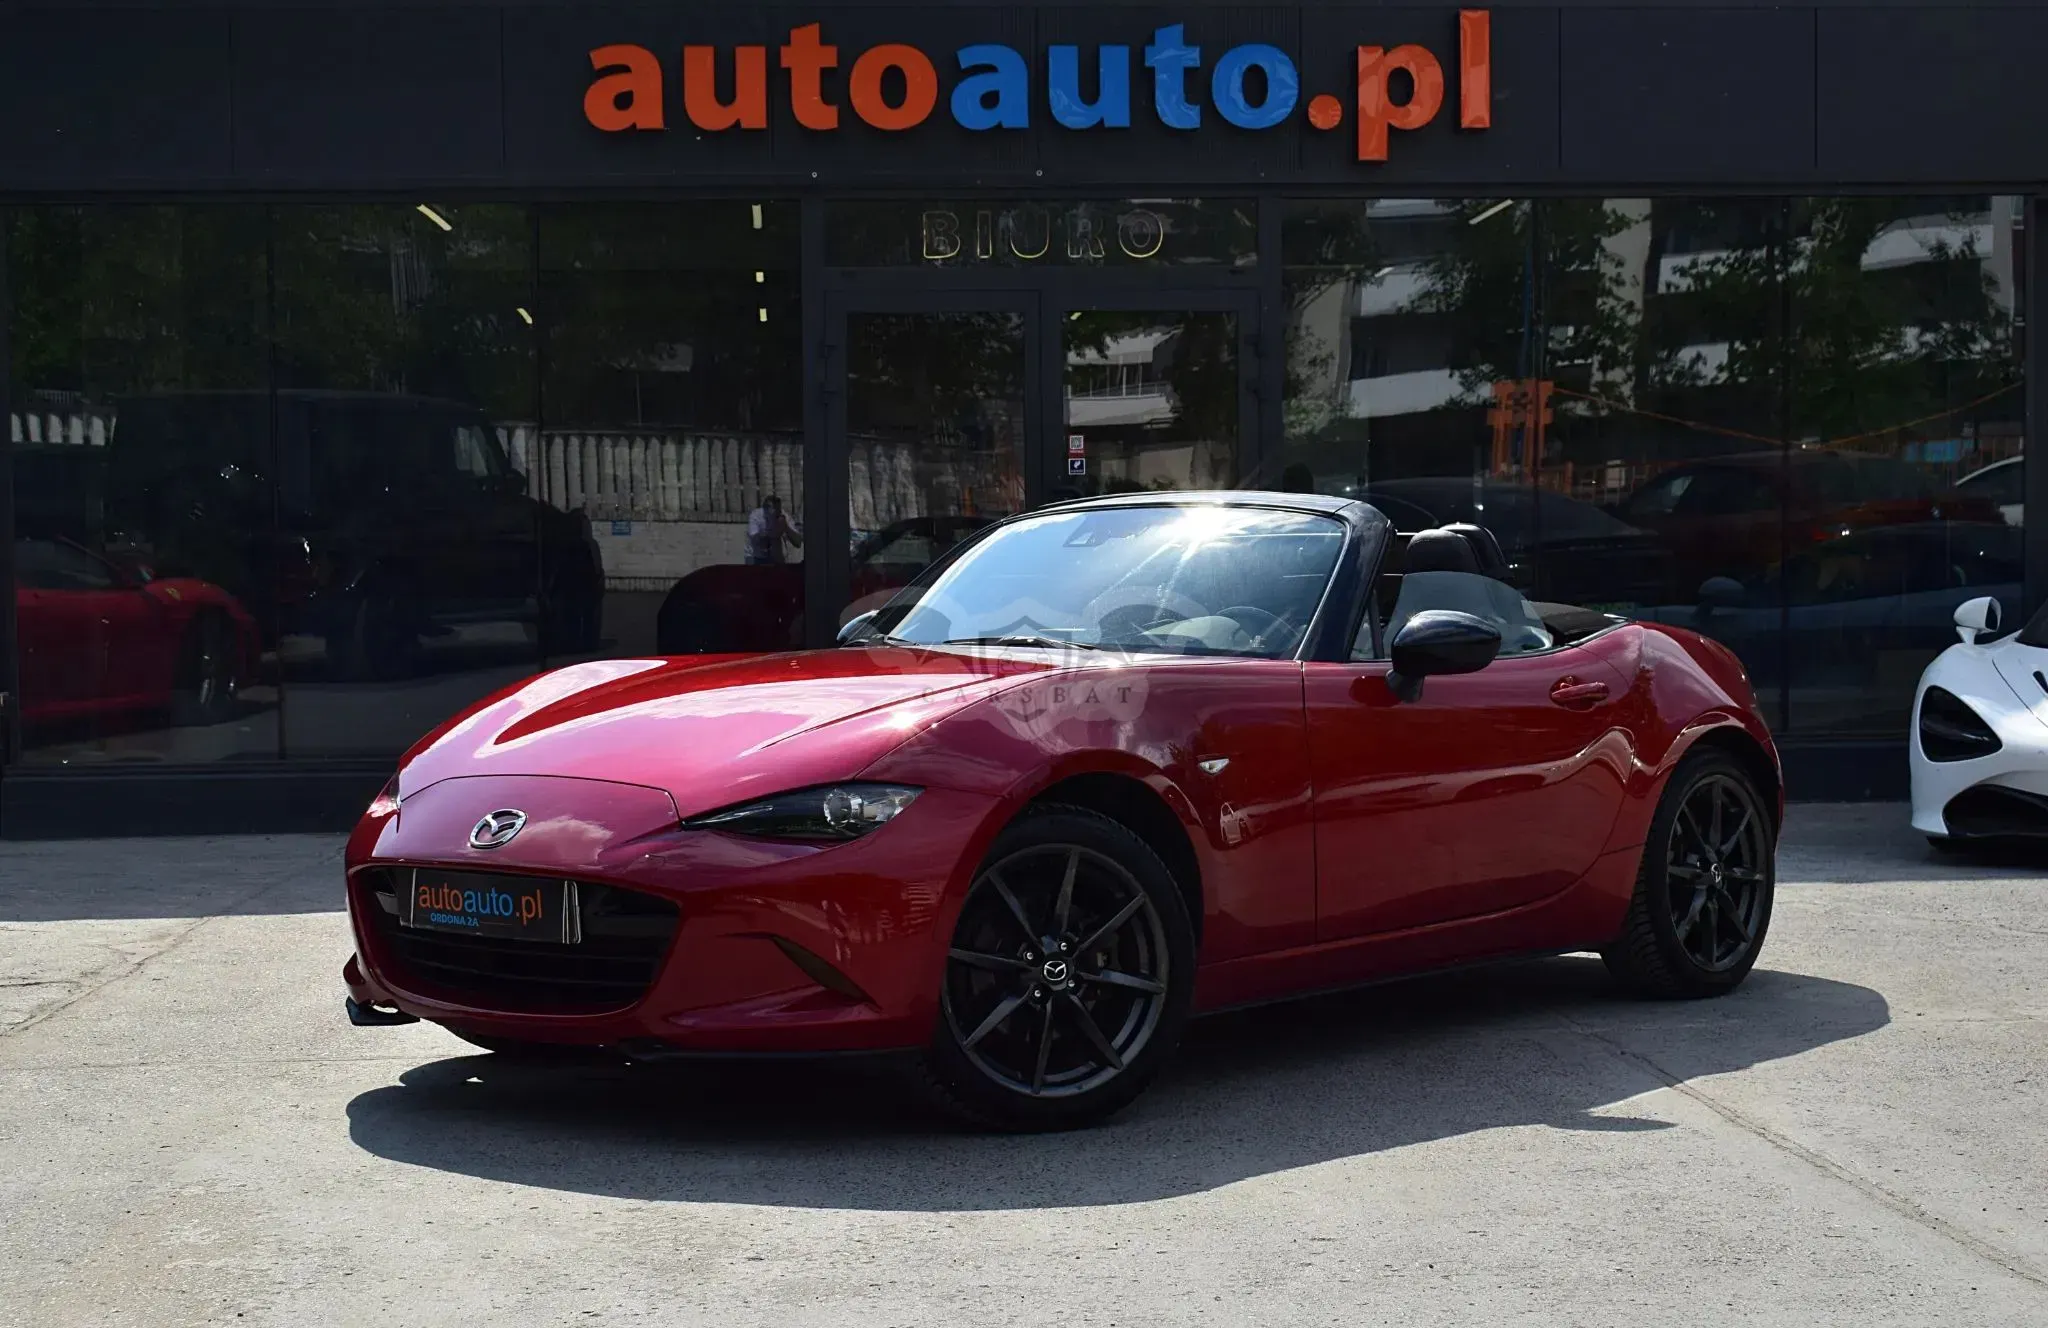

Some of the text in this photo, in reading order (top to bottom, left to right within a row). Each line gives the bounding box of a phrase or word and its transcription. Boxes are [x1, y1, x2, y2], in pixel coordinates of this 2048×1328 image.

[584, 9, 1490, 162] autoauto.pl
[922, 209, 1164, 259] BIURO
[419, 883, 543, 926] autoauto.pl
[430, 912, 466, 926] ORDONA
